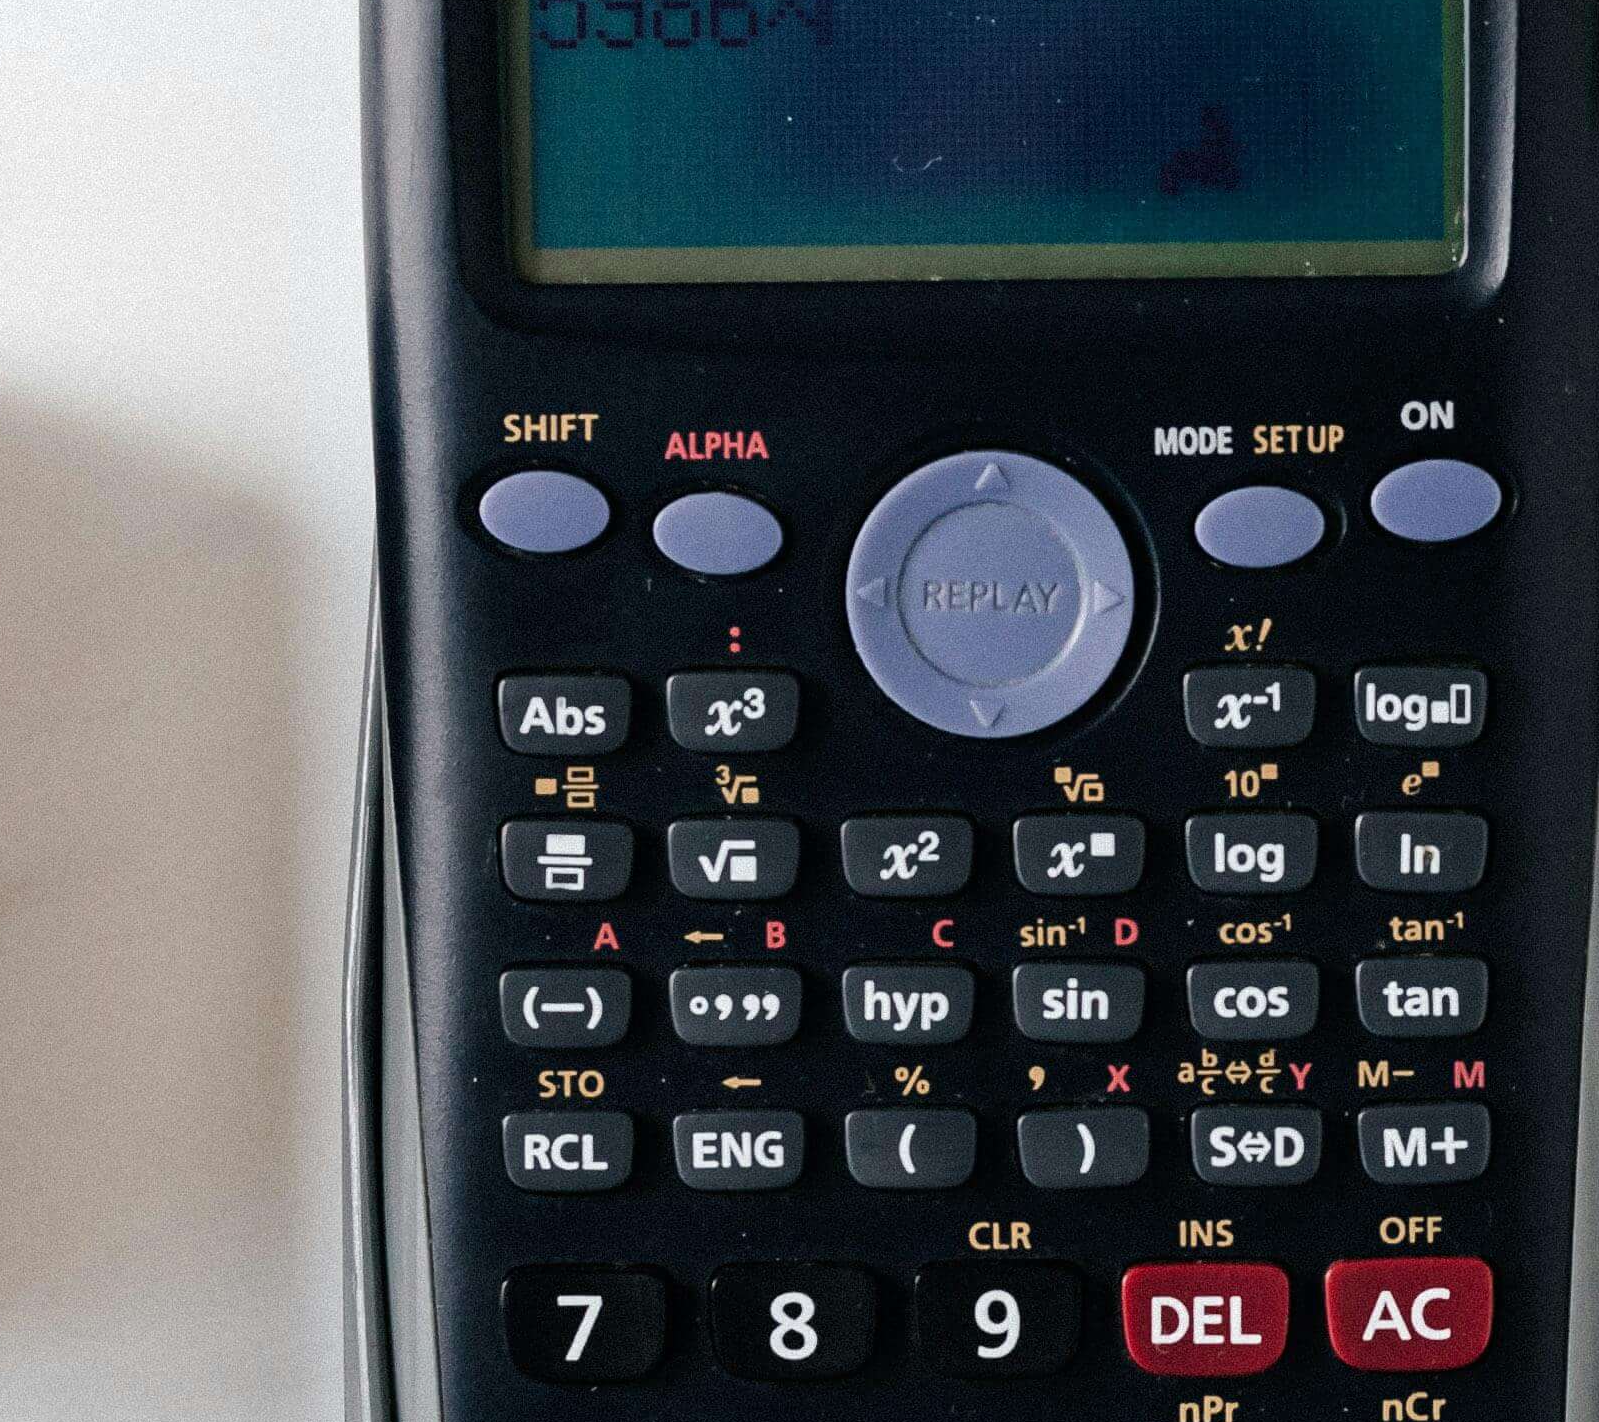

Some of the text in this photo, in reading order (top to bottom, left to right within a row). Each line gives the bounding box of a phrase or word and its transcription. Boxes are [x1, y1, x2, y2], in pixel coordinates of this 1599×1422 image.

[503, 413, 599, 443] SHIFT
[1400, 400, 1455, 431] ON
[664, 430, 769, 461] ALPHA
[1154, 425, 1233, 456] MODE
[1253, 424, 1345, 455] SET UP
[922, 579, 1060, 613] REPLAY
[519, 696, 606, 736] Abs
[1214, 832, 1285, 883] log
[1400, 833, 1441, 875] ln
[593, 922, 620, 950] A
[766, 920, 786, 949] B
[931, 918, 954, 948] C
[1114, 917, 1139, 946] D
[863, 979, 949, 1032] hyp
[1042, 977, 1109, 1020] sin
[1213, 986, 1290, 1019] cos
[1382, 980, 1460, 1017] tan
[538, 1069, 605, 1099] STO
[1107, 1064, 1130, 1093] X
[1289, 1062, 1312, 1091] Y
[1453, 1060, 1485, 1088] M
[523, 1133, 609, 1171] RCL
[692, 1130, 784, 1169] ENG
[1382, 1126, 1469, 1168] M+
[968, 1221, 1032, 1251] CLR
[1179, 1219, 1234, 1248] INS
[1379, 1215, 1442, 1245] OFF
[556, 1294, 603, 1362] 7
[769, 1291, 819, 1361] 8
[974, 1289, 1021, 1359] 9
[1150, 1295, 1263, 1345] DEL
[1362, 1287, 1452, 1342] AC
[1382, 1391, 1447, 1422] nCr
